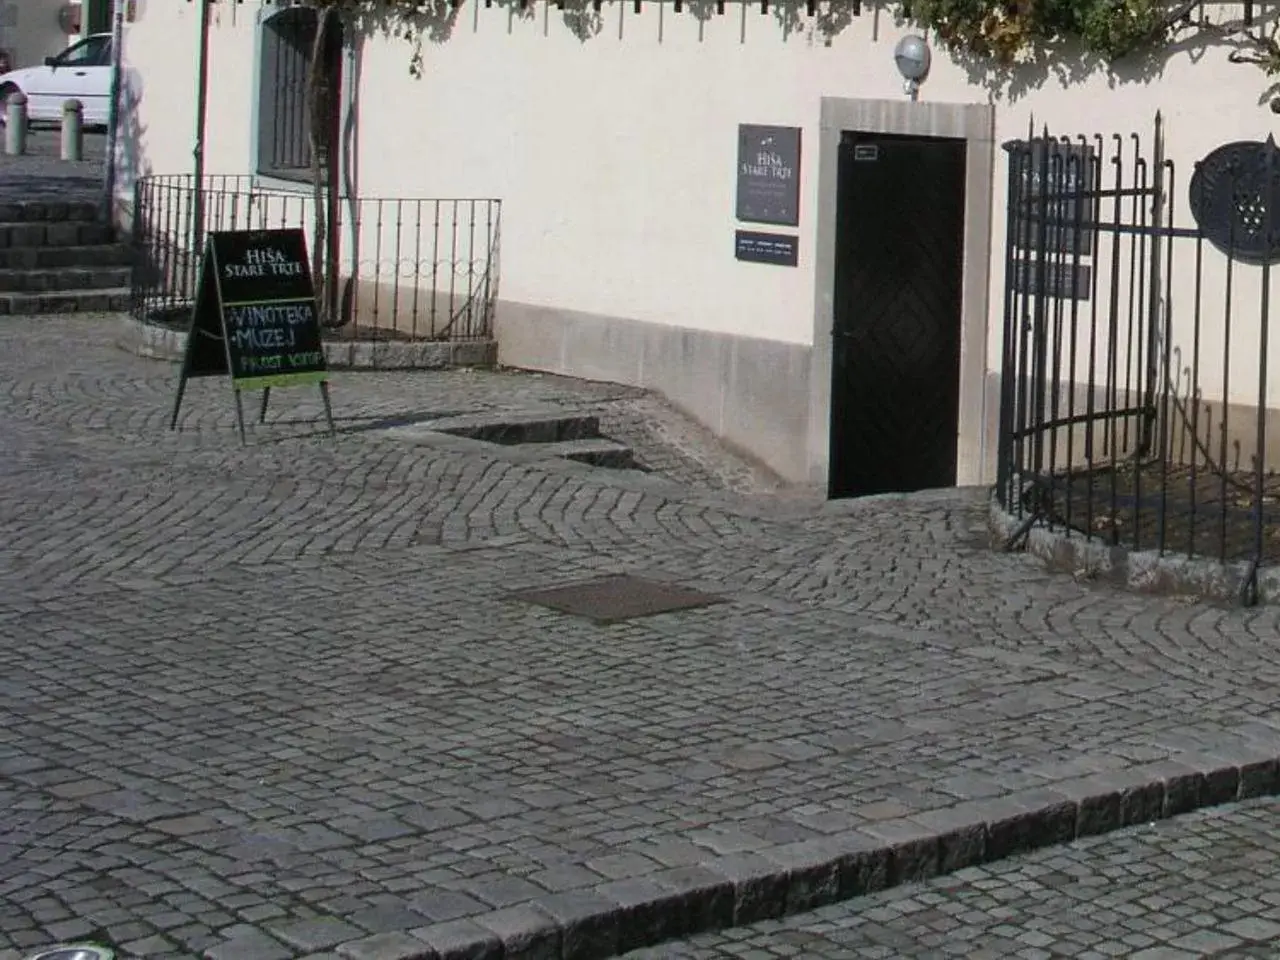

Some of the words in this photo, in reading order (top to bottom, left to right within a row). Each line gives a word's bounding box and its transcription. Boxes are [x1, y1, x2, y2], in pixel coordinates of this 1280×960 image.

[246, 247, 286, 264] HIŠA
[225, 262, 265, 278] STARE
[236, 327, 297, 348] MUZEJ
